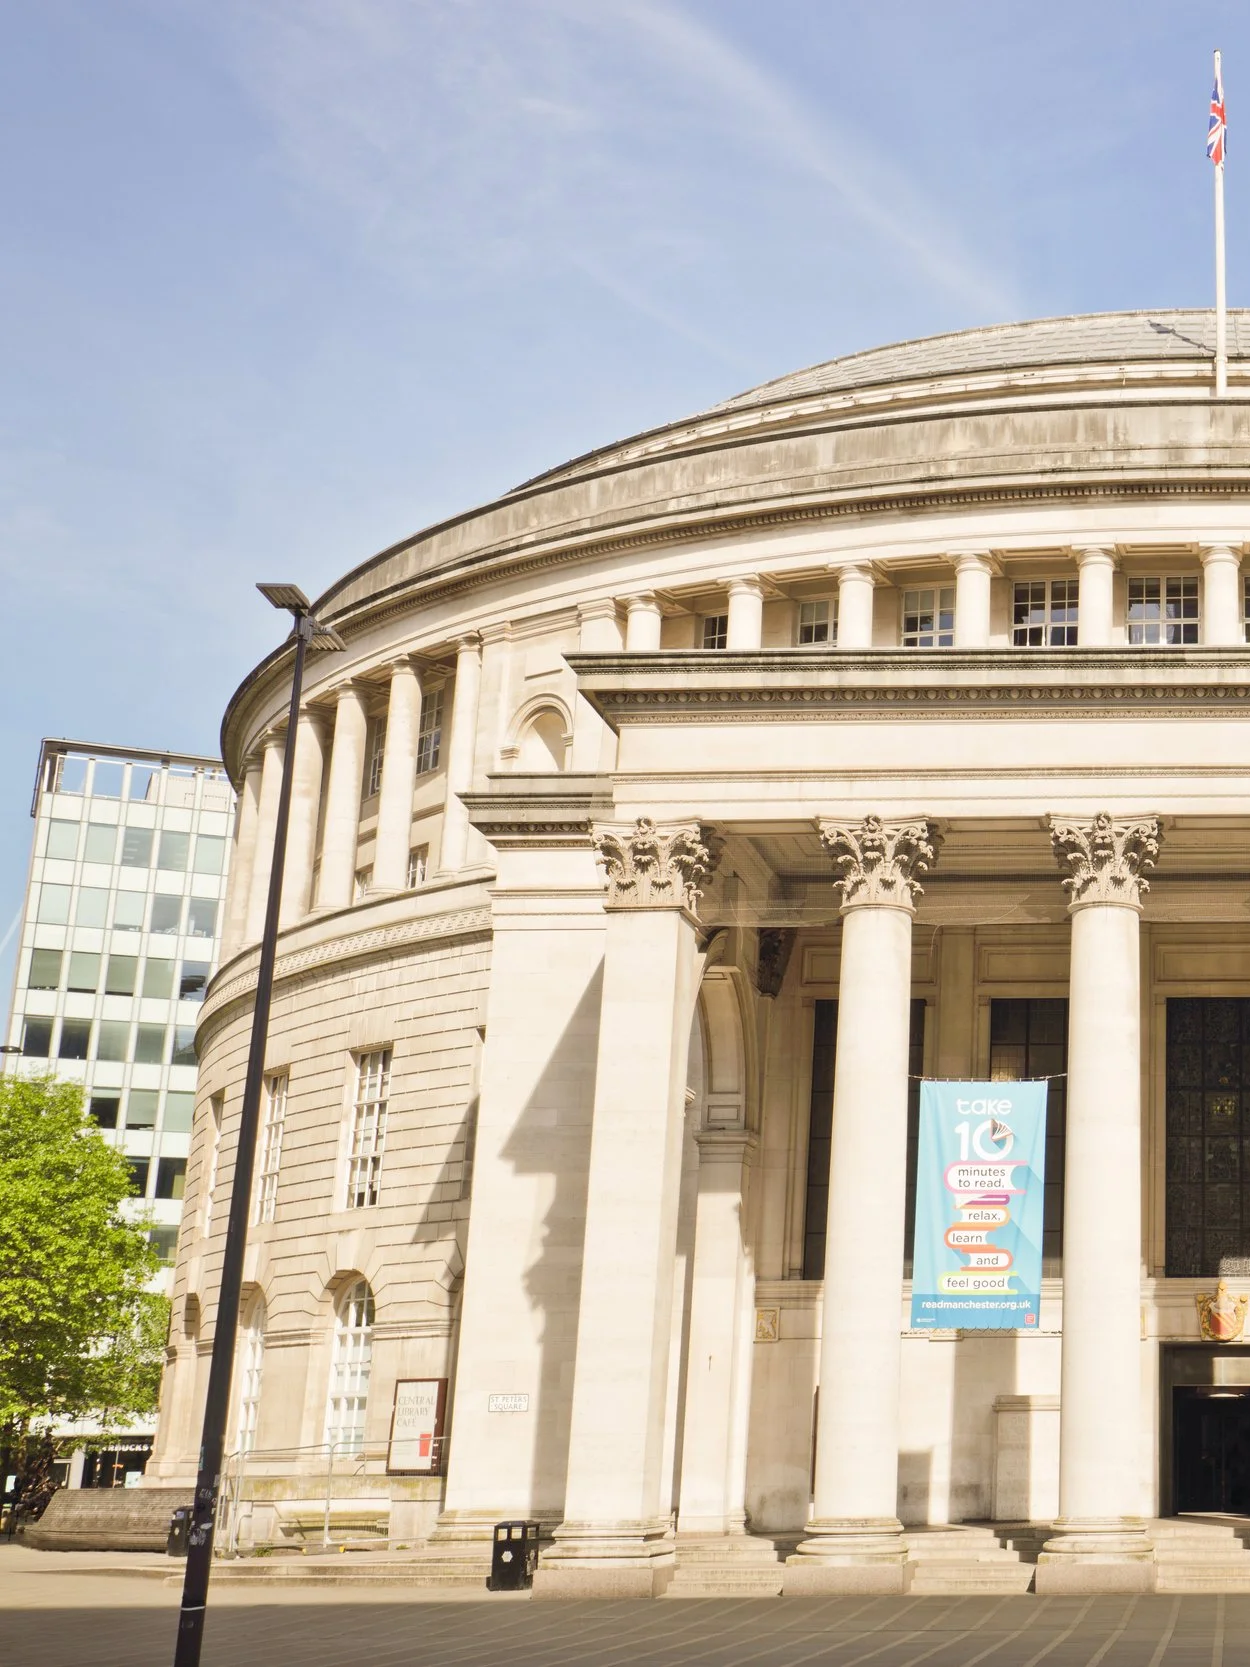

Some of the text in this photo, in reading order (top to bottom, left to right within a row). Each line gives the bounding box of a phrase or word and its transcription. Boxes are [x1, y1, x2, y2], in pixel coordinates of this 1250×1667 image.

[956, 1098, 1013, 1115] take
[954, 1119, 1015, 1162] 10
[957, 1166, 1006, 1178] minutes
[957, 1178, 1005, 1190] to read,
[968, 1211, 1001, 1222] relax,
[952, 1233, 983, 1244] learn
[976, 1255, 999, 1266] and
[947, 1277, 1005, 1291] feel good
[921, 1299, 1031, 1312] readmanchester.org.uk
[398, 1395, 435, 1406] CENTRAL
[397, 1406, 430, 1417] LIBRARY
[494, 1403, 522, 1411] SQUARE
